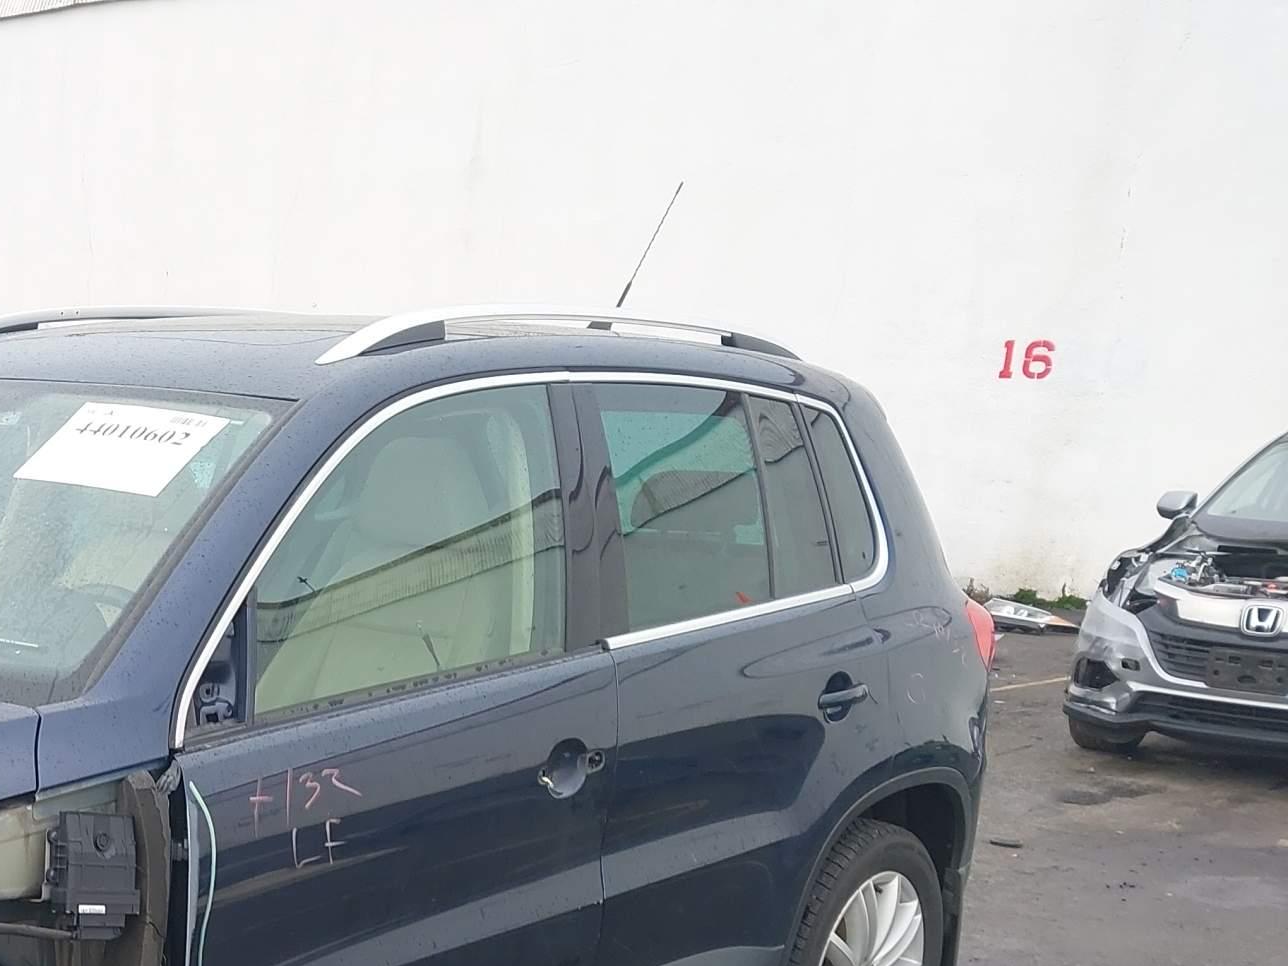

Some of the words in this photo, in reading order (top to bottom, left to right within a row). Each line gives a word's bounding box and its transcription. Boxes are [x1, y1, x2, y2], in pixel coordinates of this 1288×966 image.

[998, 340, 1056, 379] 16
[75, 421, 192, 446] 44010602
[292, 817, 347, 869] LF
